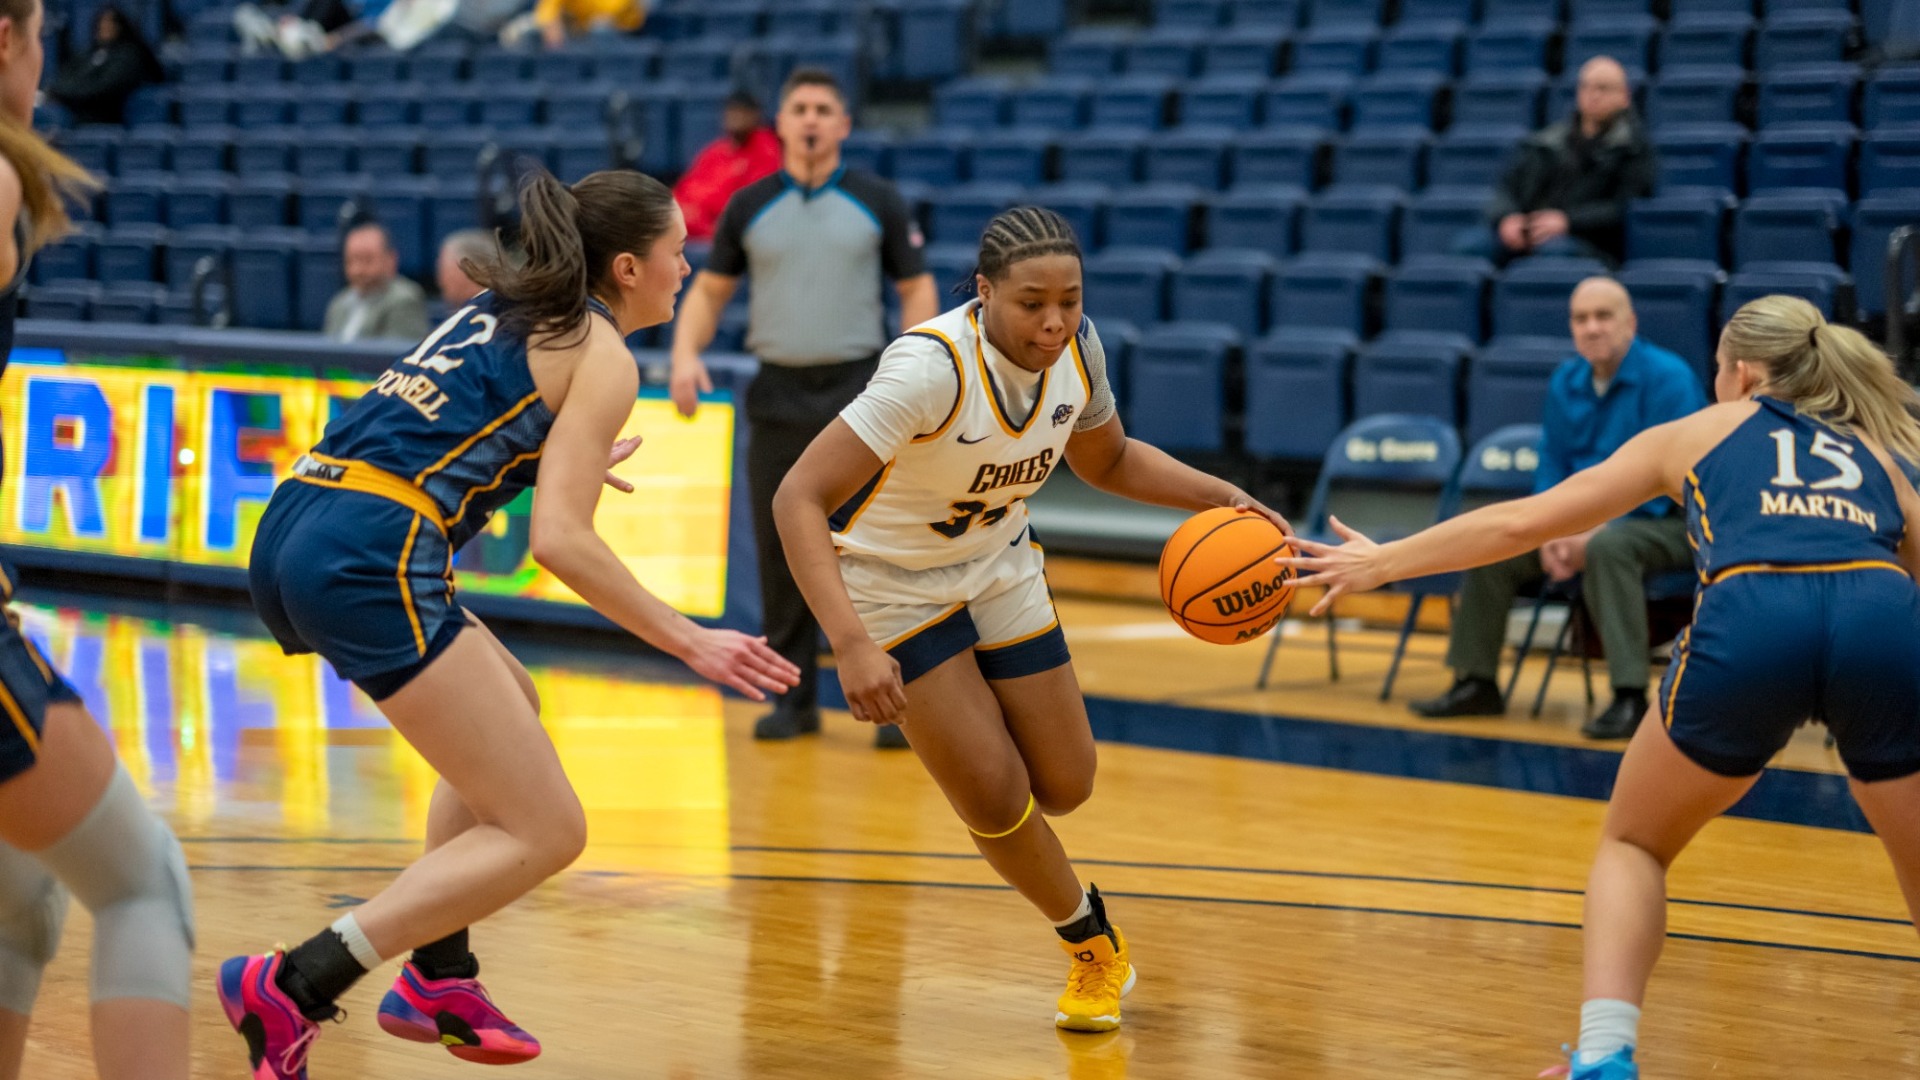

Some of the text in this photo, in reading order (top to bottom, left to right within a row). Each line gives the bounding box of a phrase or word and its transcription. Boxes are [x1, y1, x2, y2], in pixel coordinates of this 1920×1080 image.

[402, 305, 498, 375] 12
[20, 375, 345, 551] RIF
[967, 447, 1054, 494] GRIFFS
[1768, 429, 1863, 490] 15
[1760, 489, 1877, 533] MARTIN
[1212, 566, 1292, 617] Wilson
